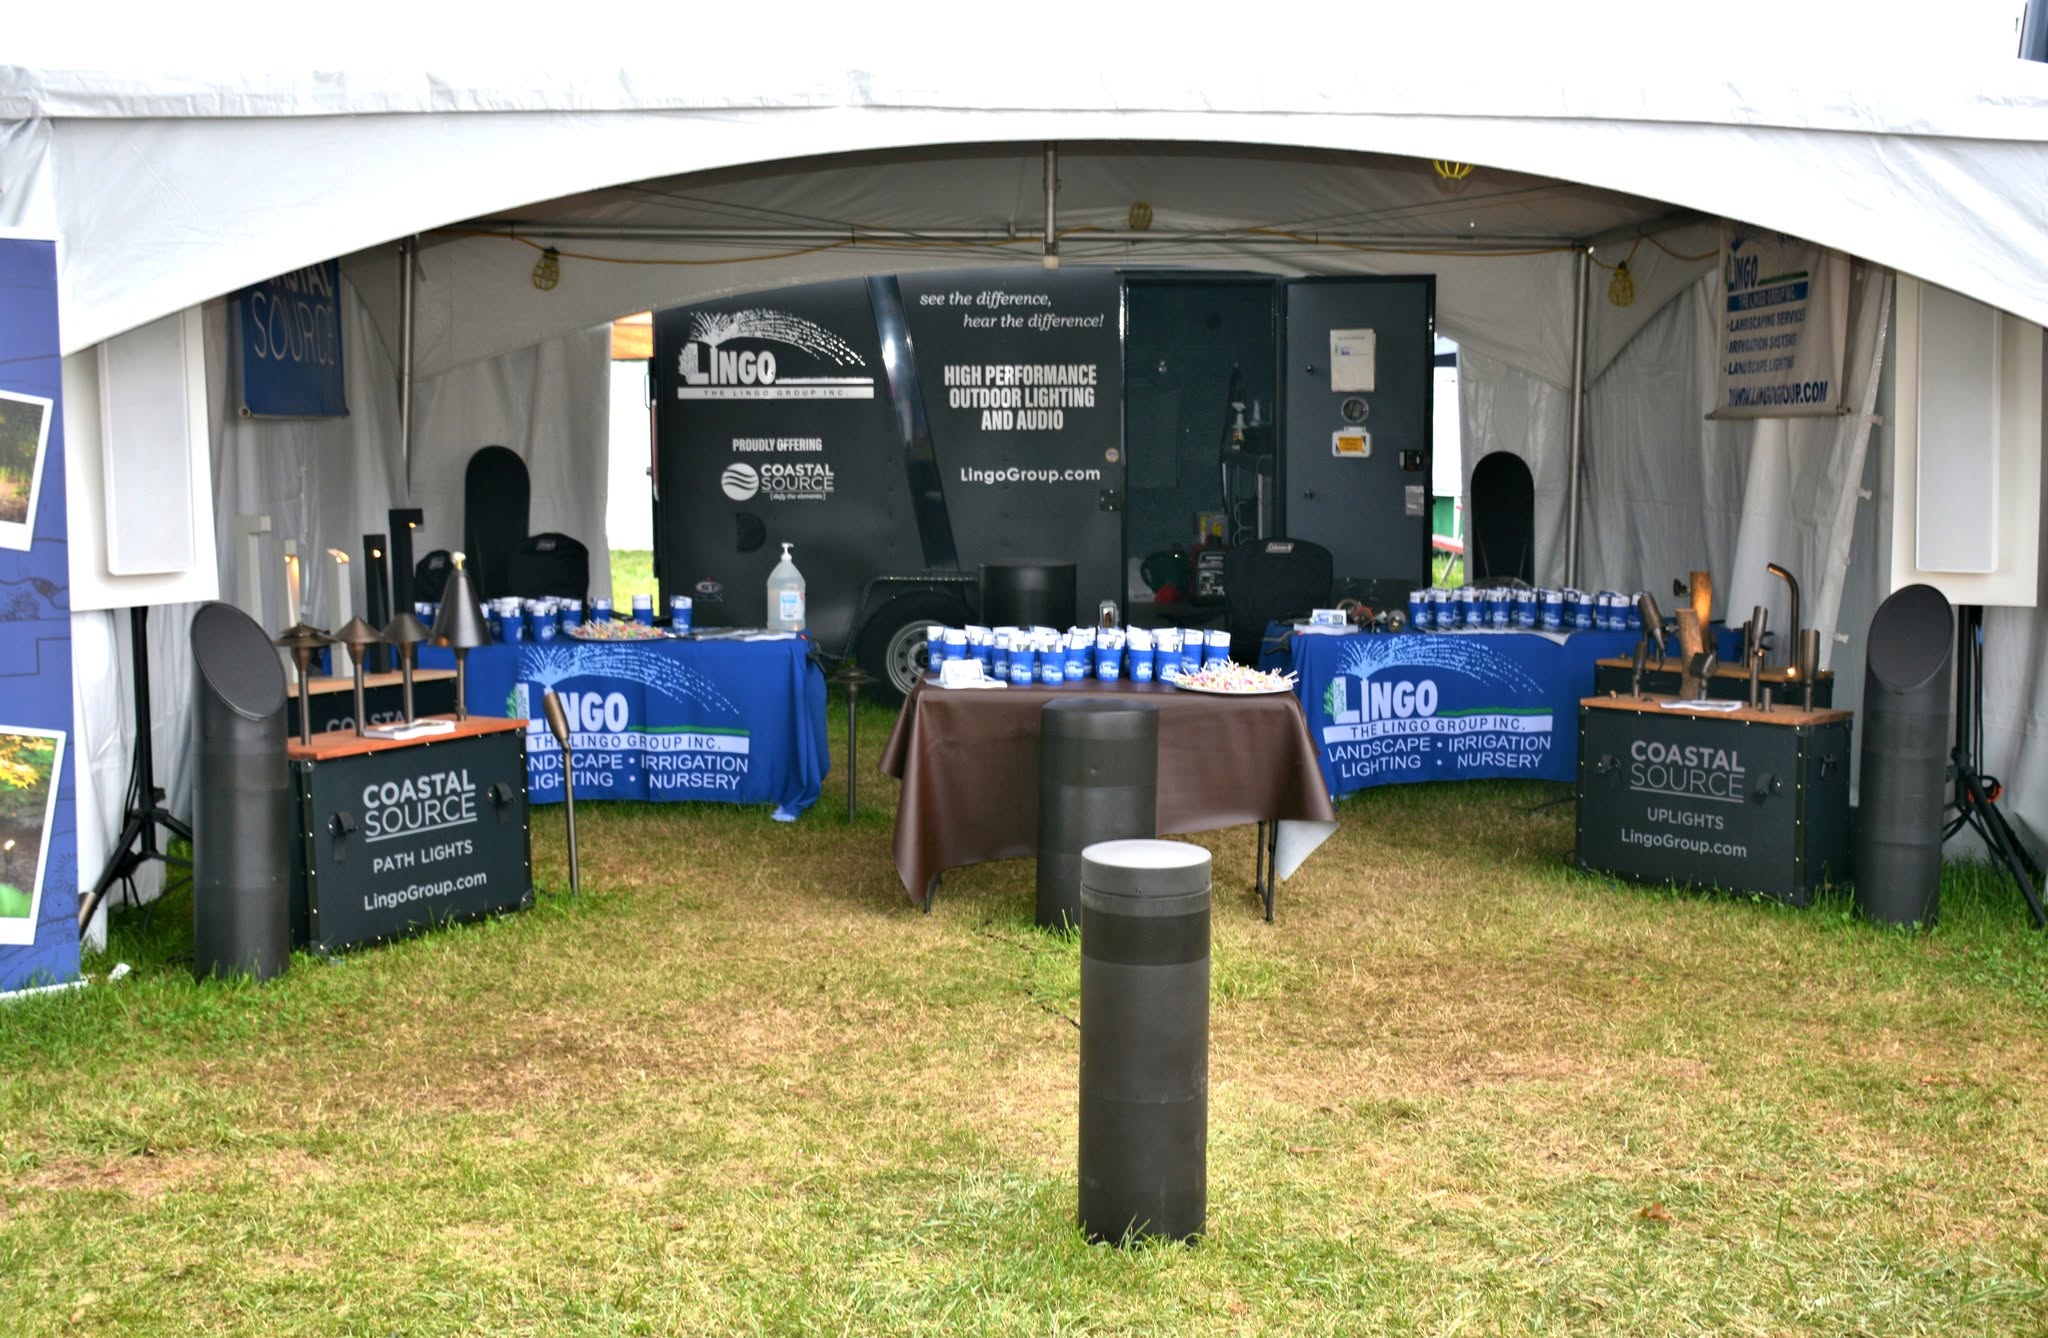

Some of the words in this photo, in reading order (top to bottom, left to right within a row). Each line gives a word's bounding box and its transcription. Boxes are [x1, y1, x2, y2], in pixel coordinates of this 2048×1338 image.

[919, 294, 945, 306] see
[949, 291, 972, 306] the
[976, 291, 1052, 309] difference,
[252, 291, 334, 365] SOURCE
[963, 314, 997, 328] hear
[1000, 314, 1024, 328] the
[1028, 314, 1105, 331] difference!
[684, 343, 776, 385] LINGO
[944, 365, 982, 386] HIGH
[985, 365, 1097, 386] PERFORMANCE
[950, 388, 1021, 408] OUTDOOR
[1025, 387, 1095, 408] LIGHTING
[981, 410, 1013, 431] AND
[1016, 410, 1064, 431] AUDIO
[732, 438, 775, 451] PROUDLY
[776, 438, 822, 451] OFFERING
[761, 464, 834, 476] COASTAL
[960, 467, 1101, 485] LingoGroup.com
[761, 477, 834, 490] SOURCE
[517, 684, 629, 732] LNGO
[1333, 676, 1438, 724] LINGO
[1351, 724, 1378, 739] THE
[1382, 717, 1430, 734] LINGO
[1436, 716, 1488, 732] GROUP
[1493, 716, 1526, 732] INC.
[533, 737, 563, 750] TH
[571, 736, 621, 748] LINGO
[627, 735, 682, 750] GROUP
[688, 737, 721, 750] INC.
[1328, 737, 1431, 762] LANDSCAPE
[1449, 736, 1551, 753] IRRIGATION
[526, 754, 623, 773] NDSCAPE
[641, 755, 748, 774] IRRIGATION
[1341, 755, 1421, 778] LIGHTING
[1457, 753, 1543, 769] NURSERY
[1631, 740, 1746, 772] COASTAL
[363, 769, 476, 808] COASTAL
[529, 772, 613, 791] IGHTING
[650, 773, 741, 790] NURSERY
[1631, 763, 1745, 799] SOURCE
[365, 792, 477, 836] SOURCE
[1647, 807, 1724, 831] UPLIGHTS
[1621, 828, 1747, 858] LingoGroup.com
[373, 852, 415, 874] PATH
[421, 839, 473, 864] LIGHTS
[364, 872, 487, 911] LingoGroup.com
